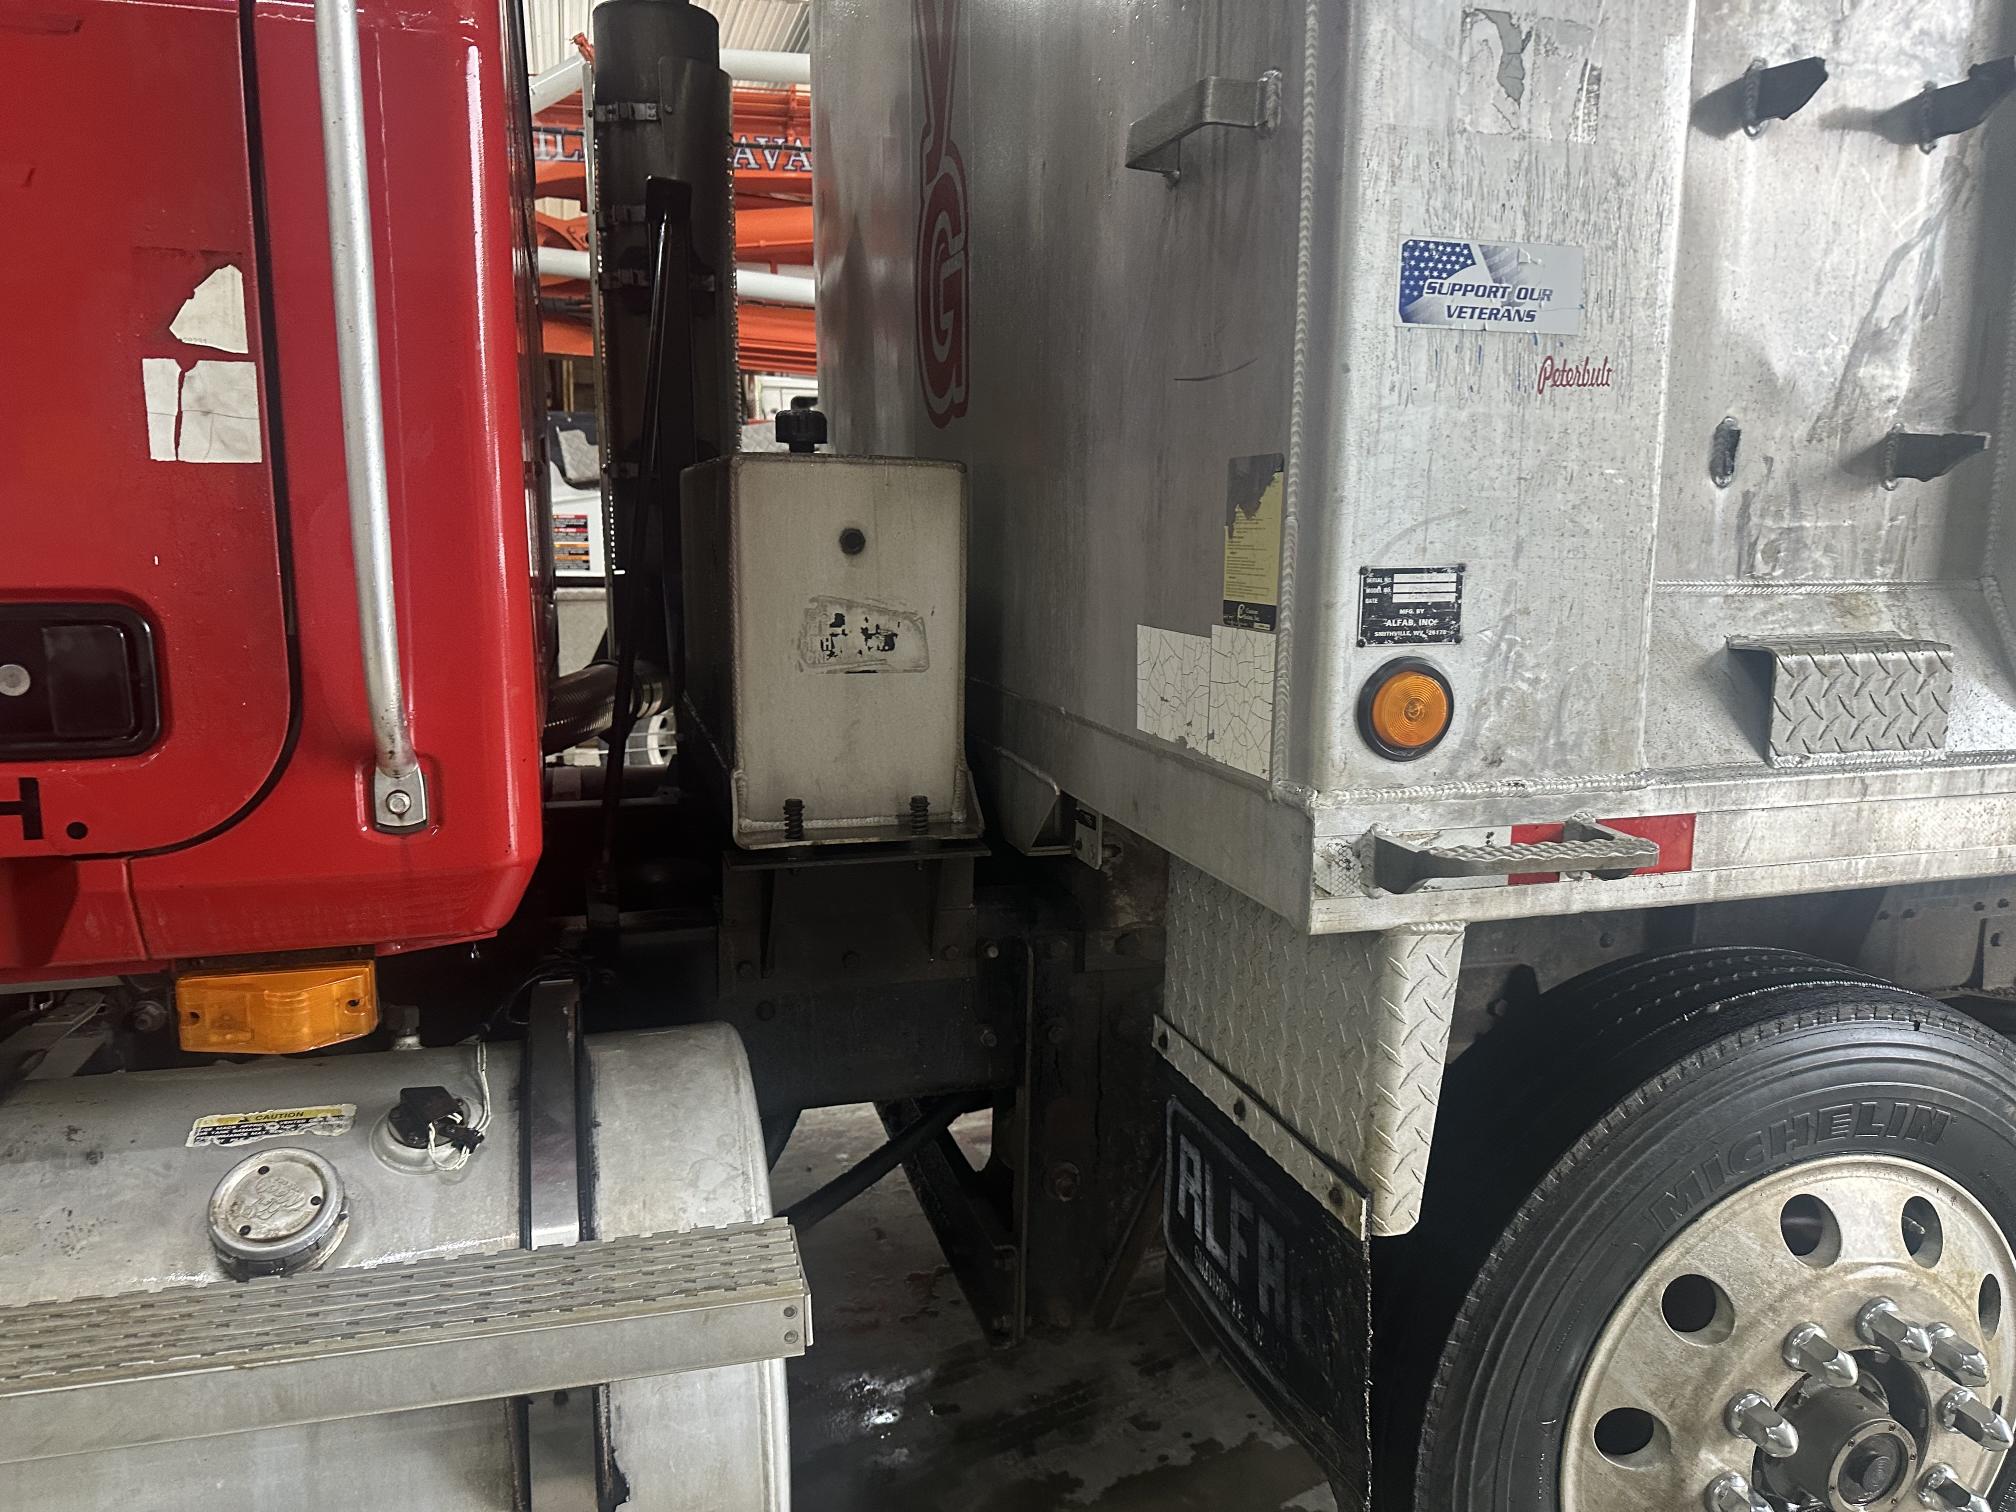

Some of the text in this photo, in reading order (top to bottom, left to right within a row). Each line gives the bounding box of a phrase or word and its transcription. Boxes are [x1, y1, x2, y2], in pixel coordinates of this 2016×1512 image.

[1424, 279, 1553, 302] SUPPORT OUR
[1445, 304, 1537, 323] VETERANS
[255, 1111, 305, 1121] CAUTION
[1648, 1101, 1952, 1231] MICHELIN
